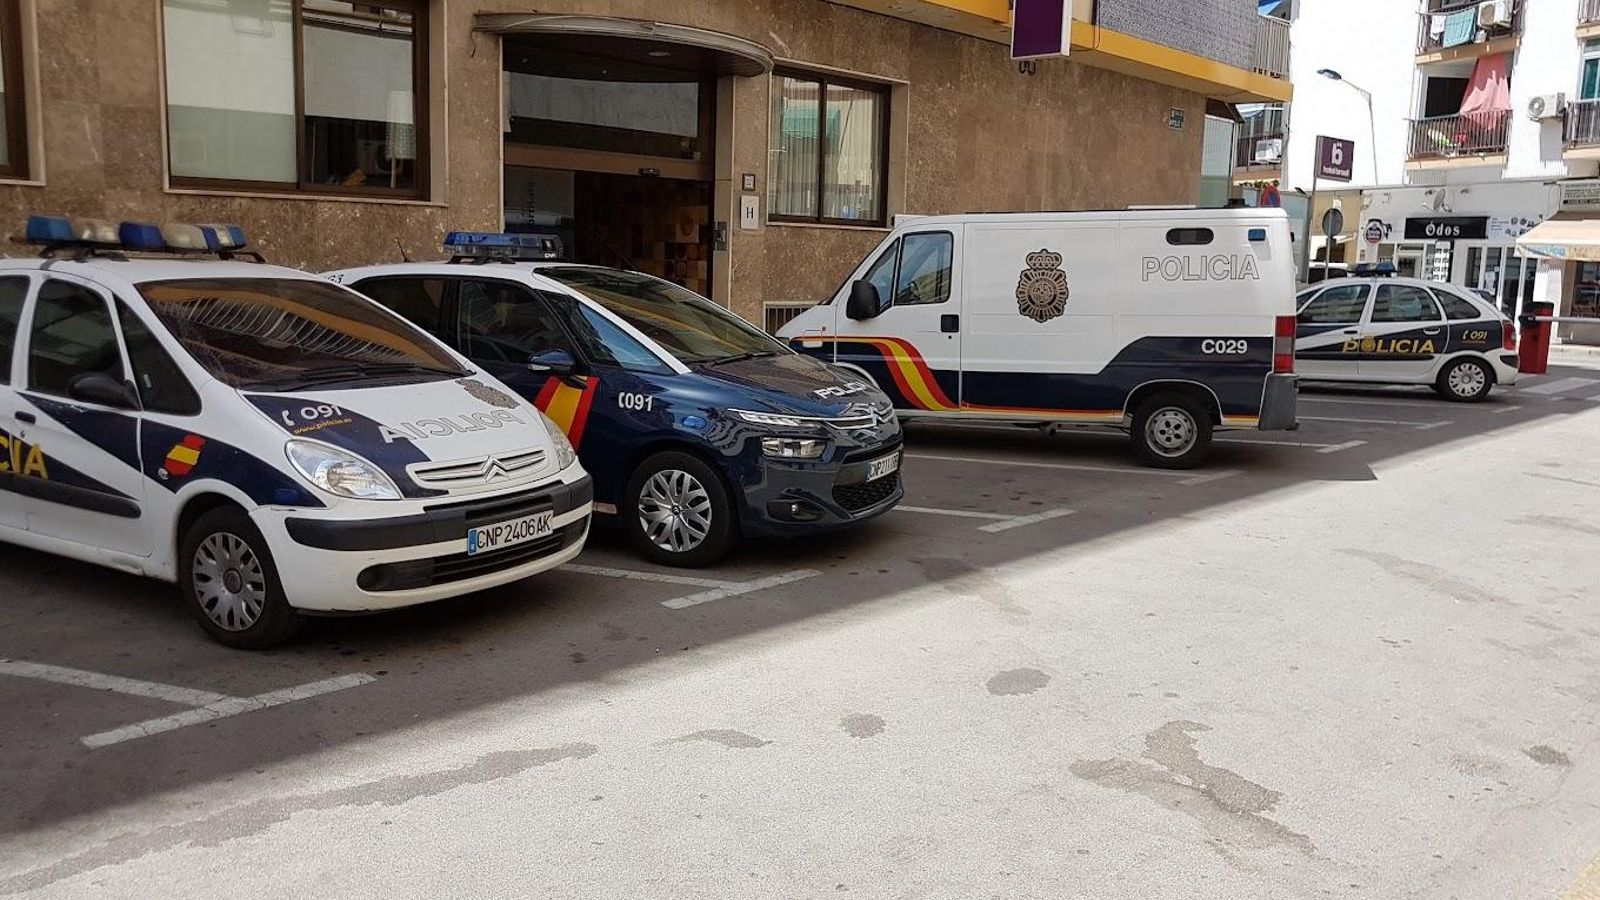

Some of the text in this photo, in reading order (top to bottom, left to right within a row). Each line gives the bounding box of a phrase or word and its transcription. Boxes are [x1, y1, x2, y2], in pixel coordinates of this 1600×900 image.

[746, 206, 754, 219] H
[1141, 254, 1260, 282] POLICIA
[1470, 331, 1488, 340] 091
[1201, 339, 1248, 354] C029
[300, 404, 343, 420] 091
